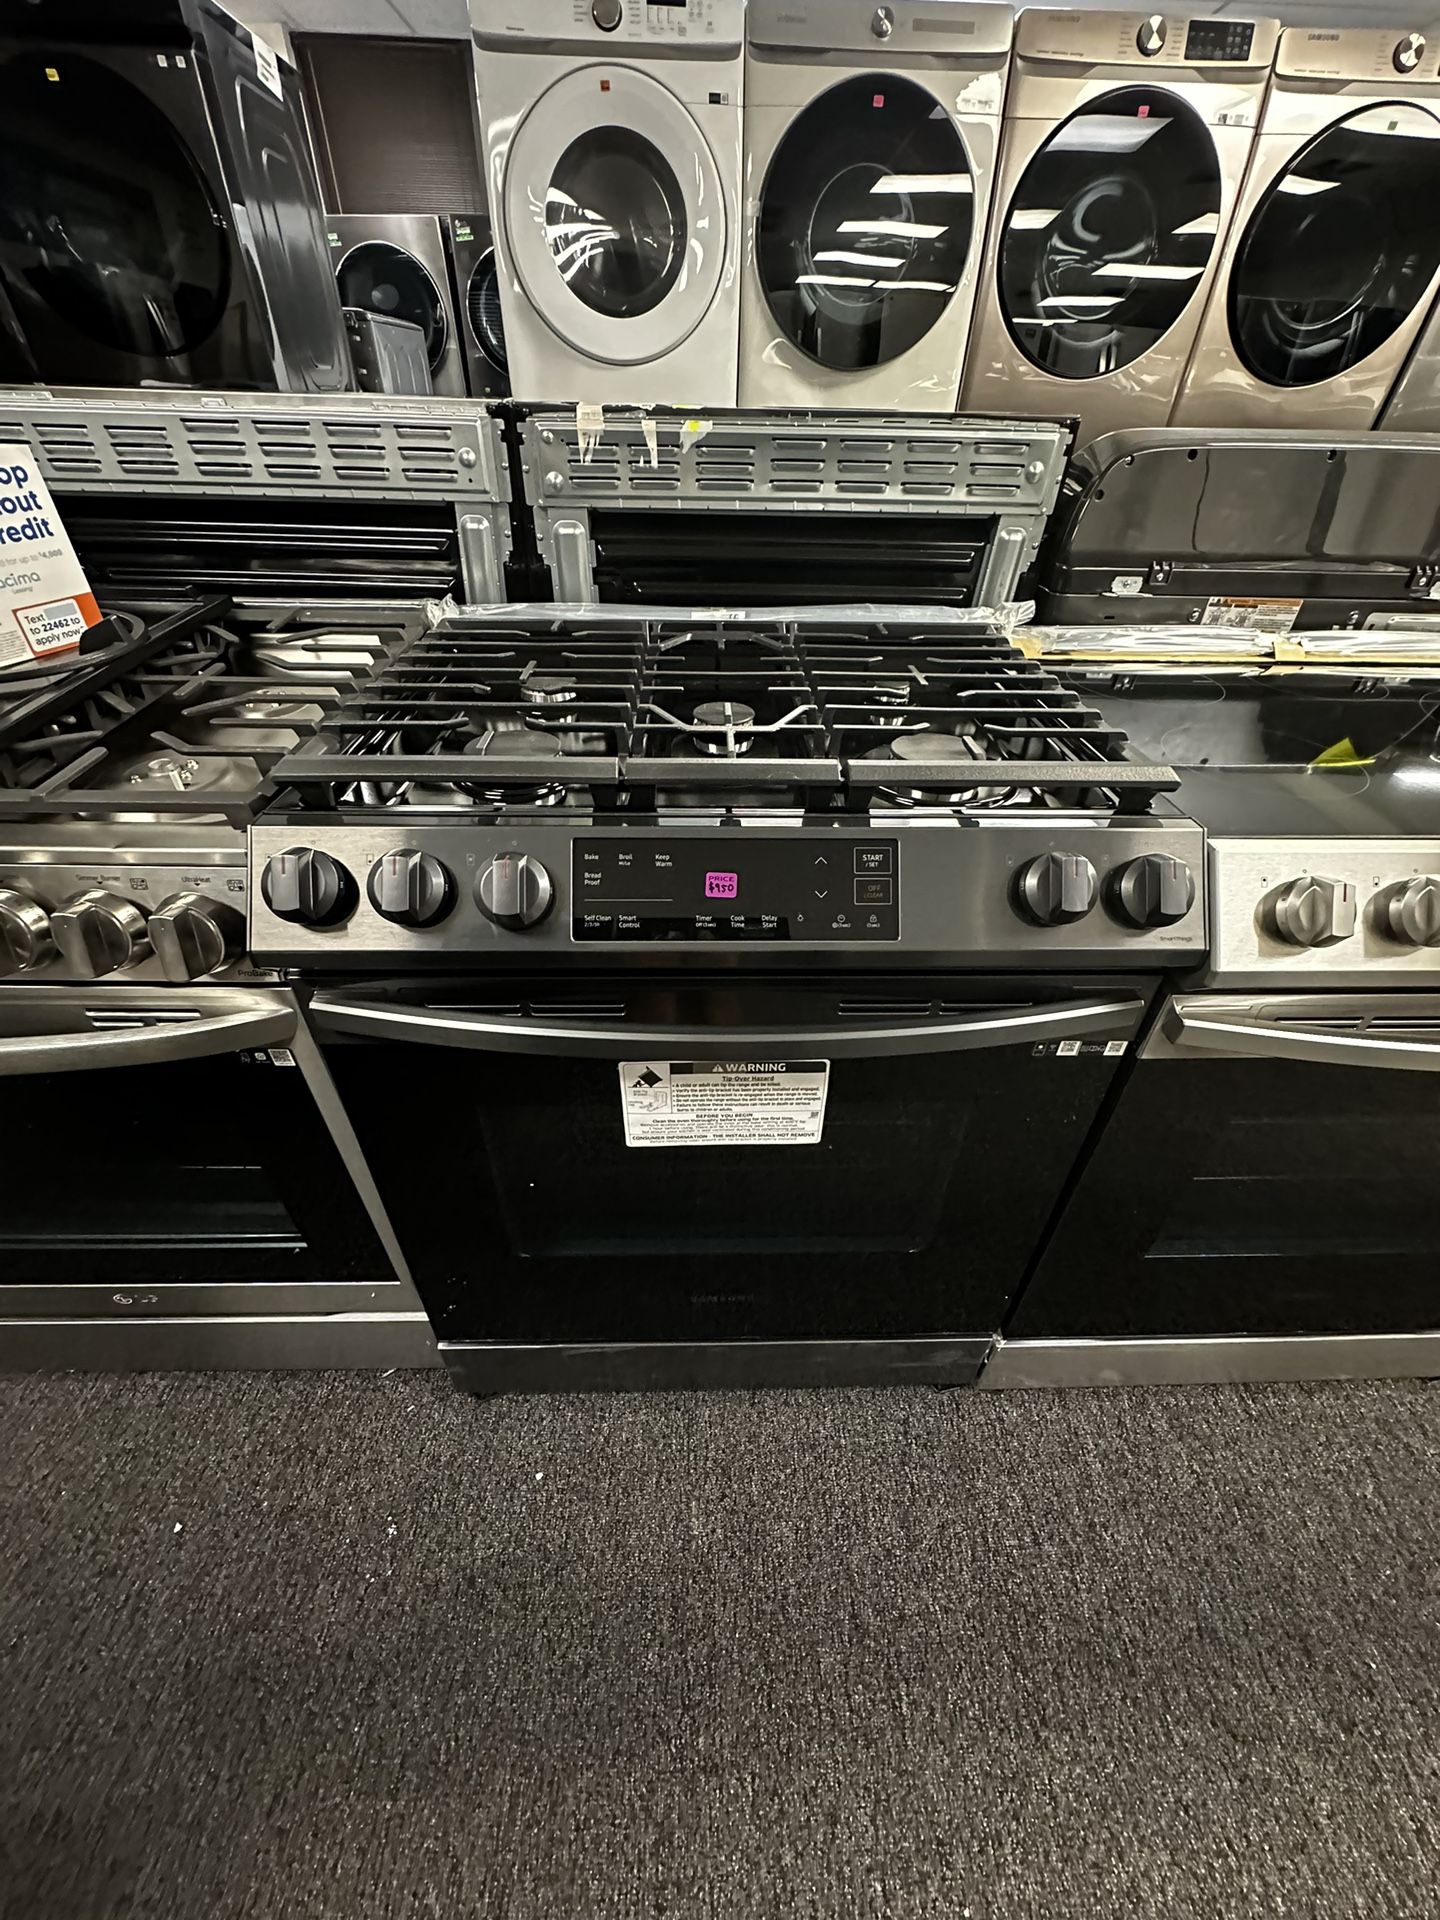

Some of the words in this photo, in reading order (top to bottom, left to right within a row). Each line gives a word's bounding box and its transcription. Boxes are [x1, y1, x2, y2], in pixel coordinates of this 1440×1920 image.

[24, 614, 46, 625] Text
[30, 627, 41, 635] to
[41, 619, 70, 632] 22462
[70, 617, 81, 625] to
[35, 633, 61, 646] apply
[655, 853, 670, 861] Keep
[708, 882, 734, 894] $950
[761, 914, 778, 922] Delay
[725, 1062, 787, 1073] WARNING
